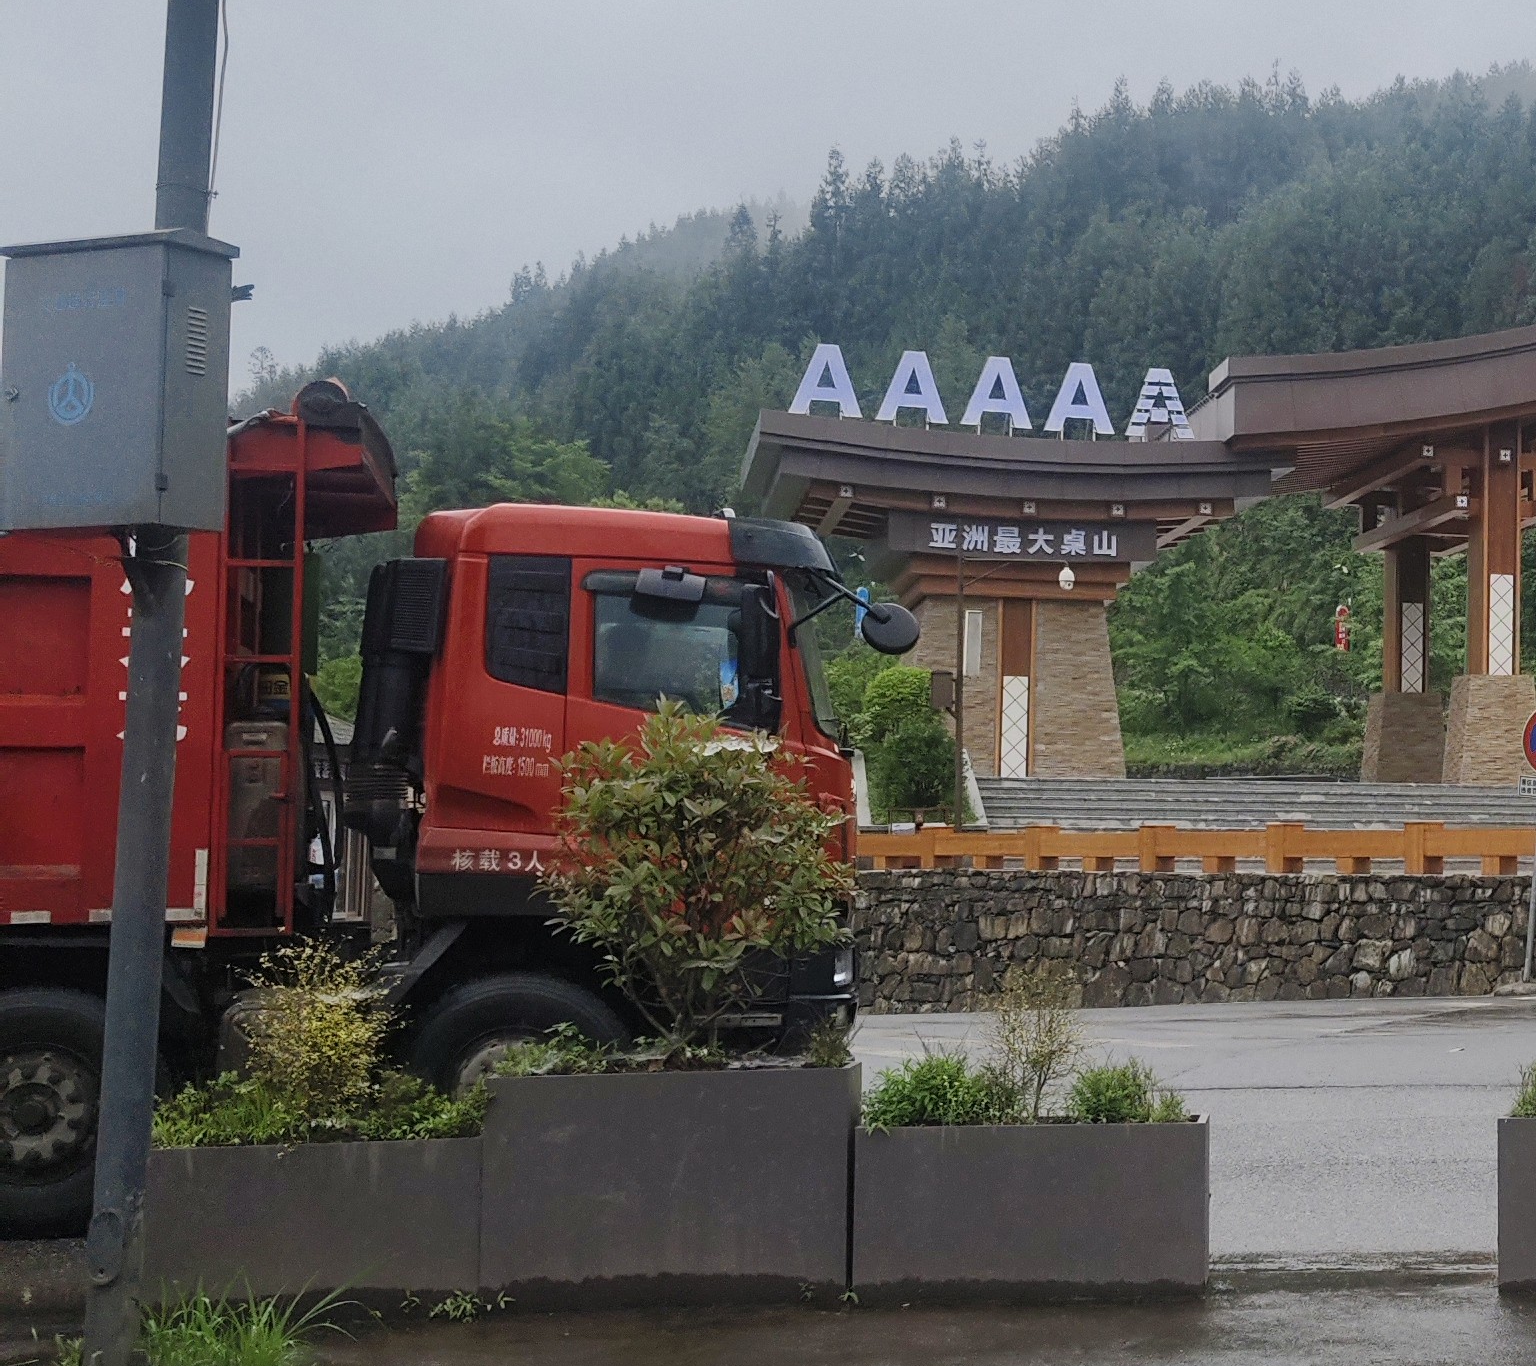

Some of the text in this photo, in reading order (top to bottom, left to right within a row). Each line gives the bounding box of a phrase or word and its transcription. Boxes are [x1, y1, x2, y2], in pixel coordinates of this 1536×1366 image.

[788, 343, 1195, 439] AAAAA
[928, 522, 1117, 557] 亚洲最大桌山
[452, 848, 545, 872] 核载3人
